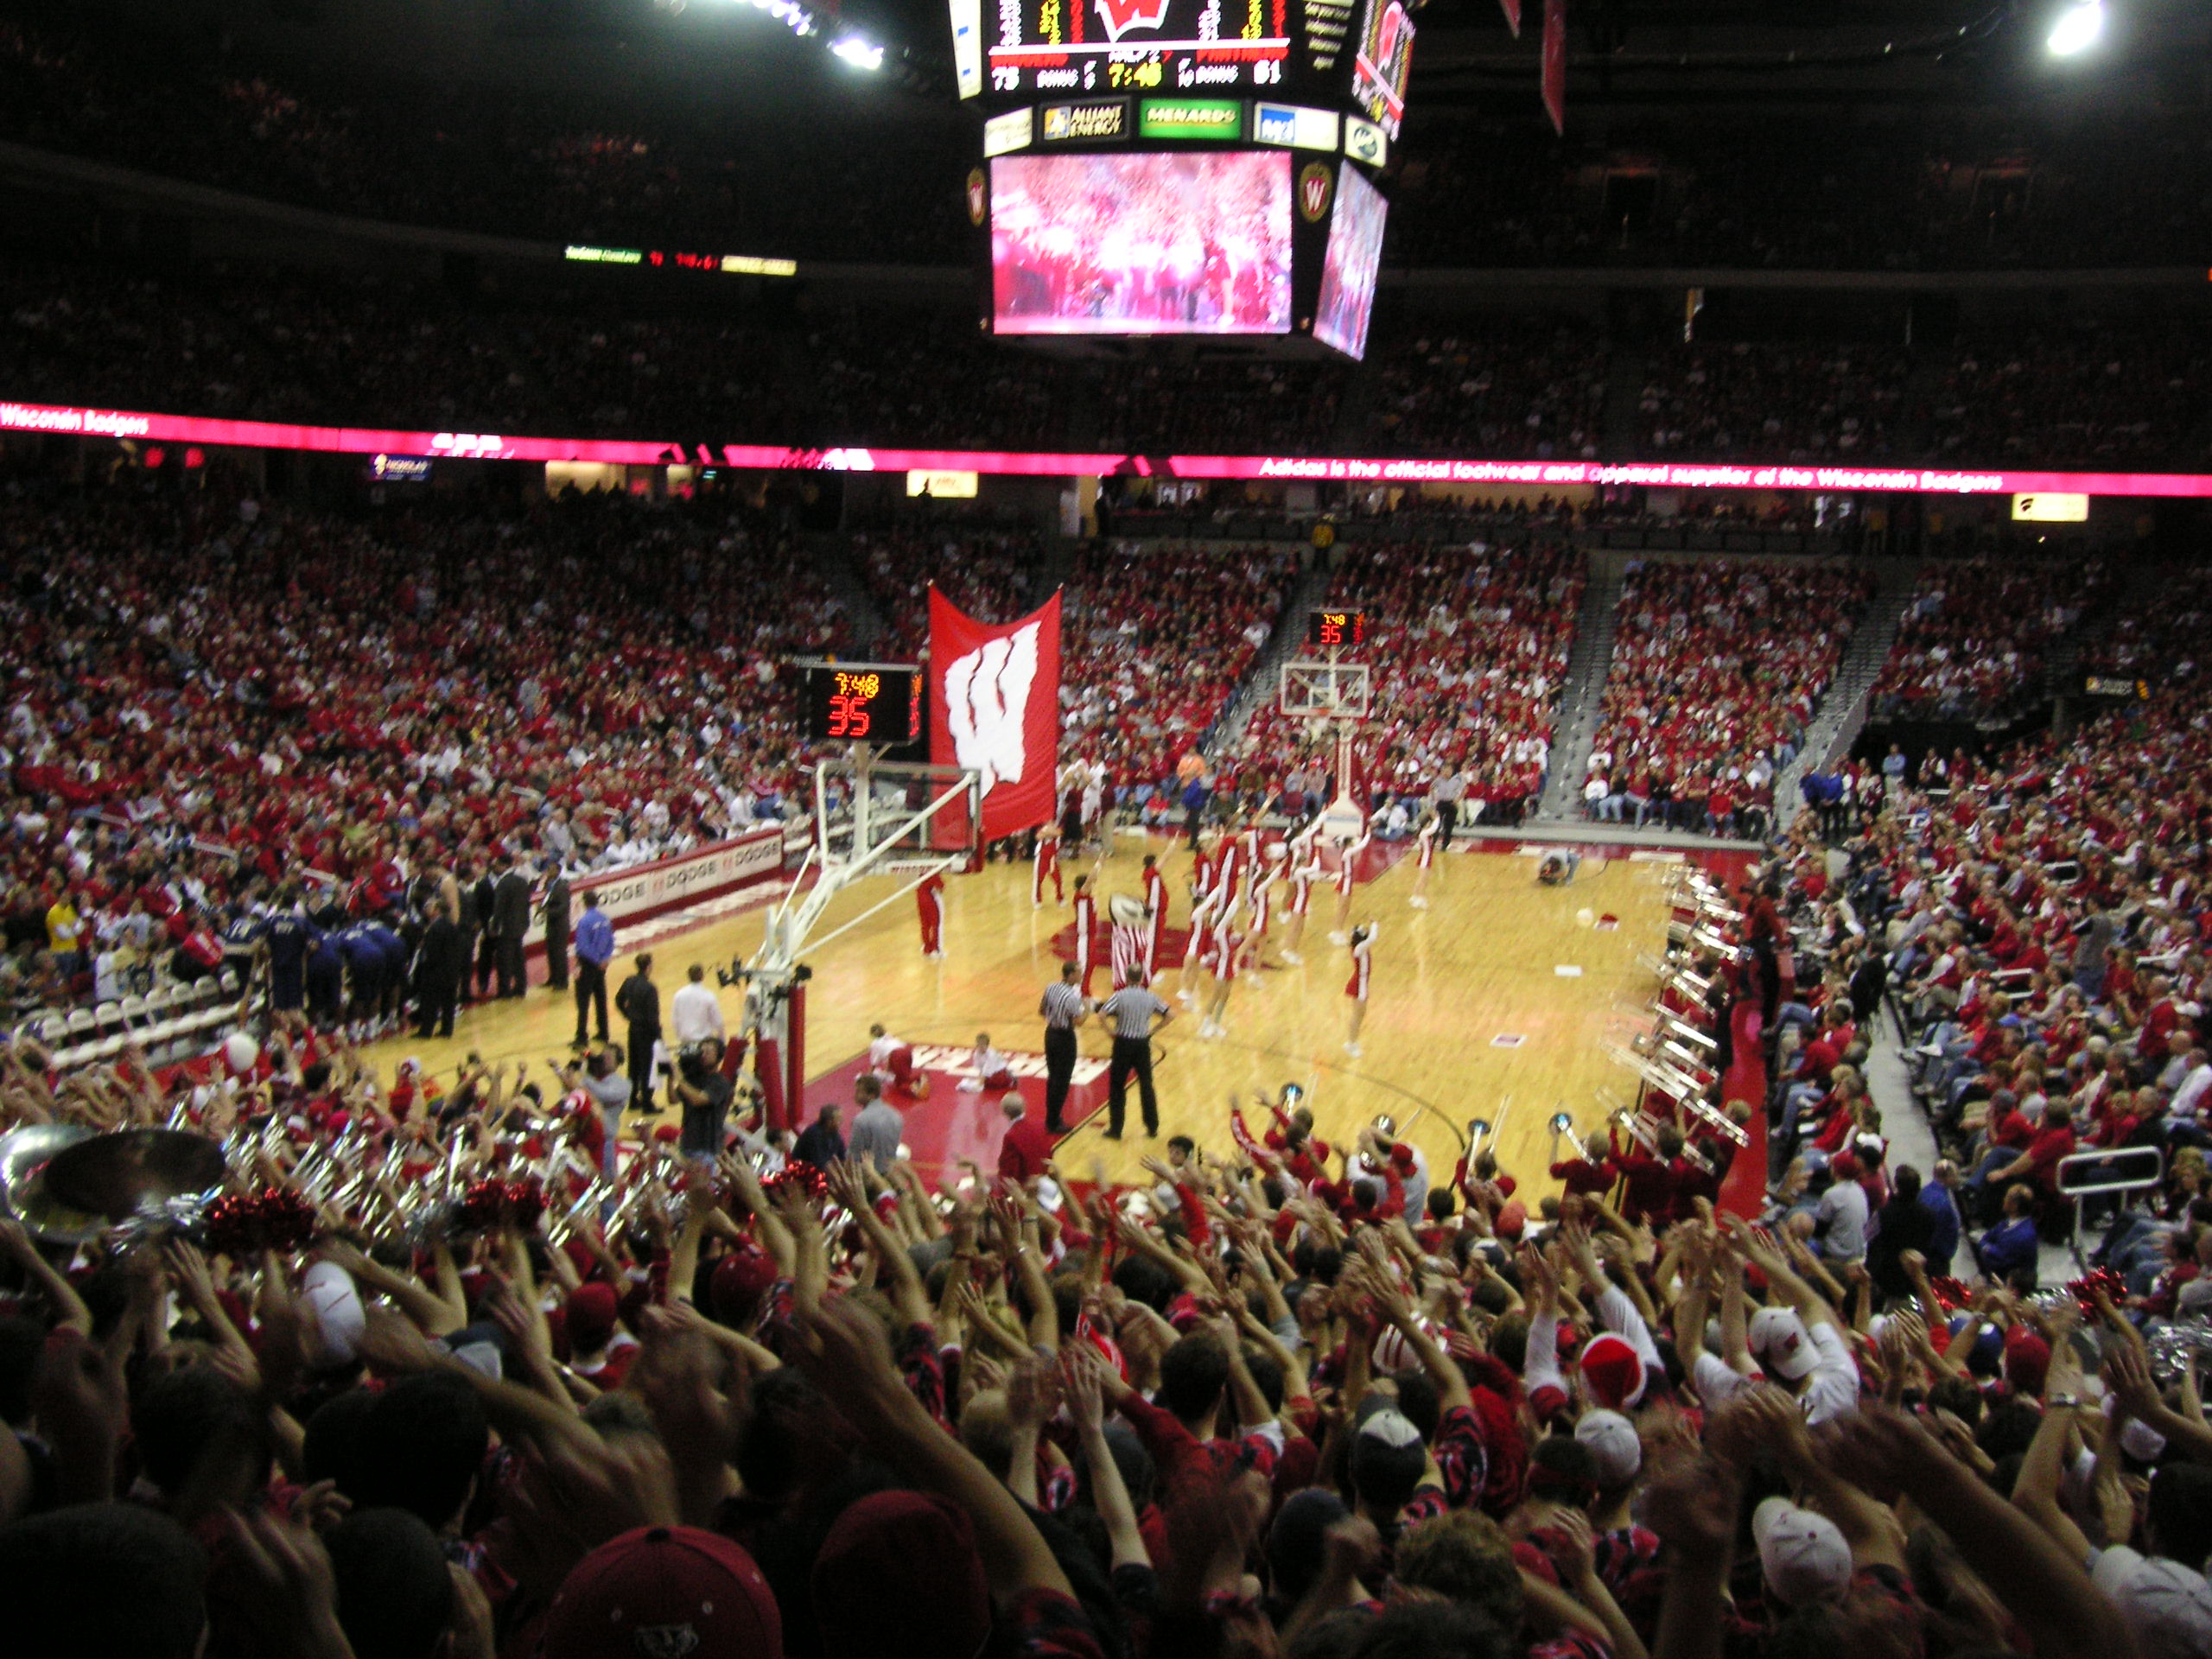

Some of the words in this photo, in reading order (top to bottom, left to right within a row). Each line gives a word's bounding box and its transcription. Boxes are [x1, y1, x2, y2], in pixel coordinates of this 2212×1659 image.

[1070, 118, 1122, 137] ENERGY
[1071, 105, 1123, 124] ALLIANT
[1146, 108, 1236, 124] MENARDS
[1306, 180, 1326, 213] W
[0, 404, 82, 431] Wisconsin
[84, 409, 149, 437] Badgers
[1258, 457, 1327, 477] Adidas
[1330, 459, 1346, 477] is
[1348, 459, 1382, 478] the
[1383, 460, 1451, 479] official
[1452, 461, 1542, 480] footwear
[1543, 463, 1586, 481] and
[1588, 465, 1669, 485] apparel
[1671, 466, 1752, 486] supplier
[1753, 467, 1777, 486] of
[1777, 467, 1815, 486] the
[1815, 468, 1917, 489] Wisconsin
[1920, 471, 2004, 493] Badgers
[1323, 613, 1346, 626] 7:48
[1320, 625, 1341, 644] 35
[834, 671, 880, 699] 7:48
[828, 695, 871, 737] 35
[735, 842, 779, 865] DODGE
[665, 861, 716, 888] DODGE
[596, 880, 645, 906] ODGE
